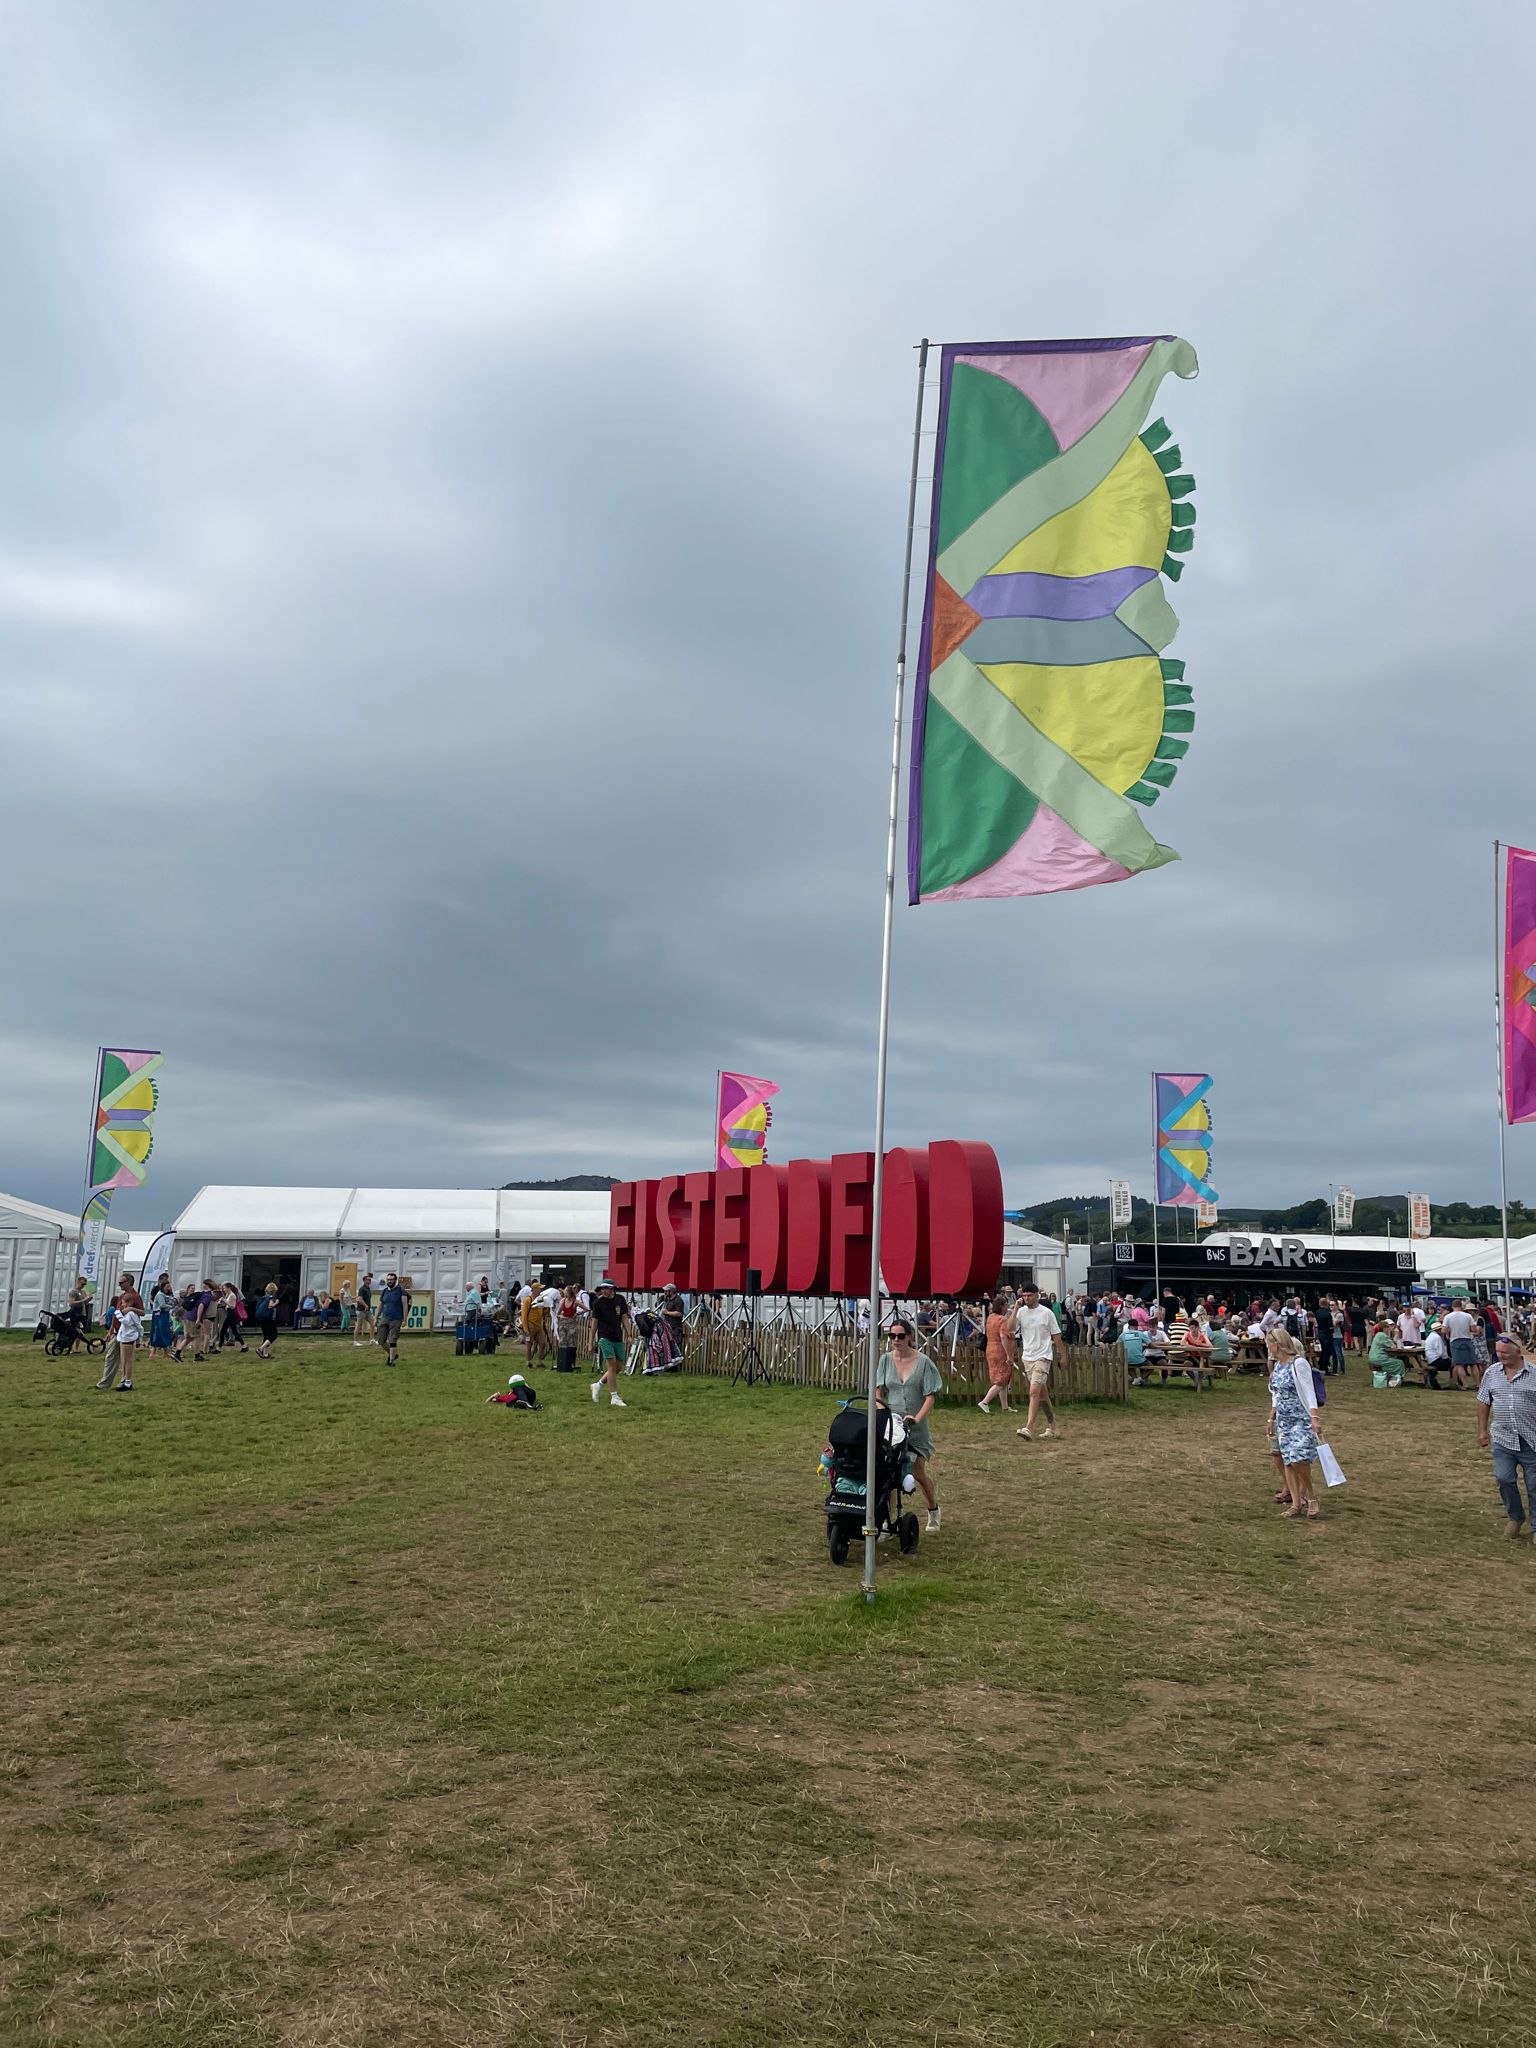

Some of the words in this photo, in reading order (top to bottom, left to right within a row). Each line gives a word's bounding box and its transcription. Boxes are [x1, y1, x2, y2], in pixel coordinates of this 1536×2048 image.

[1206, 1248, 1226, 1261] BWS
[1229, 1236, 1306, 1267] BAR
[1307, 1251, 1327, 1264] BWS
